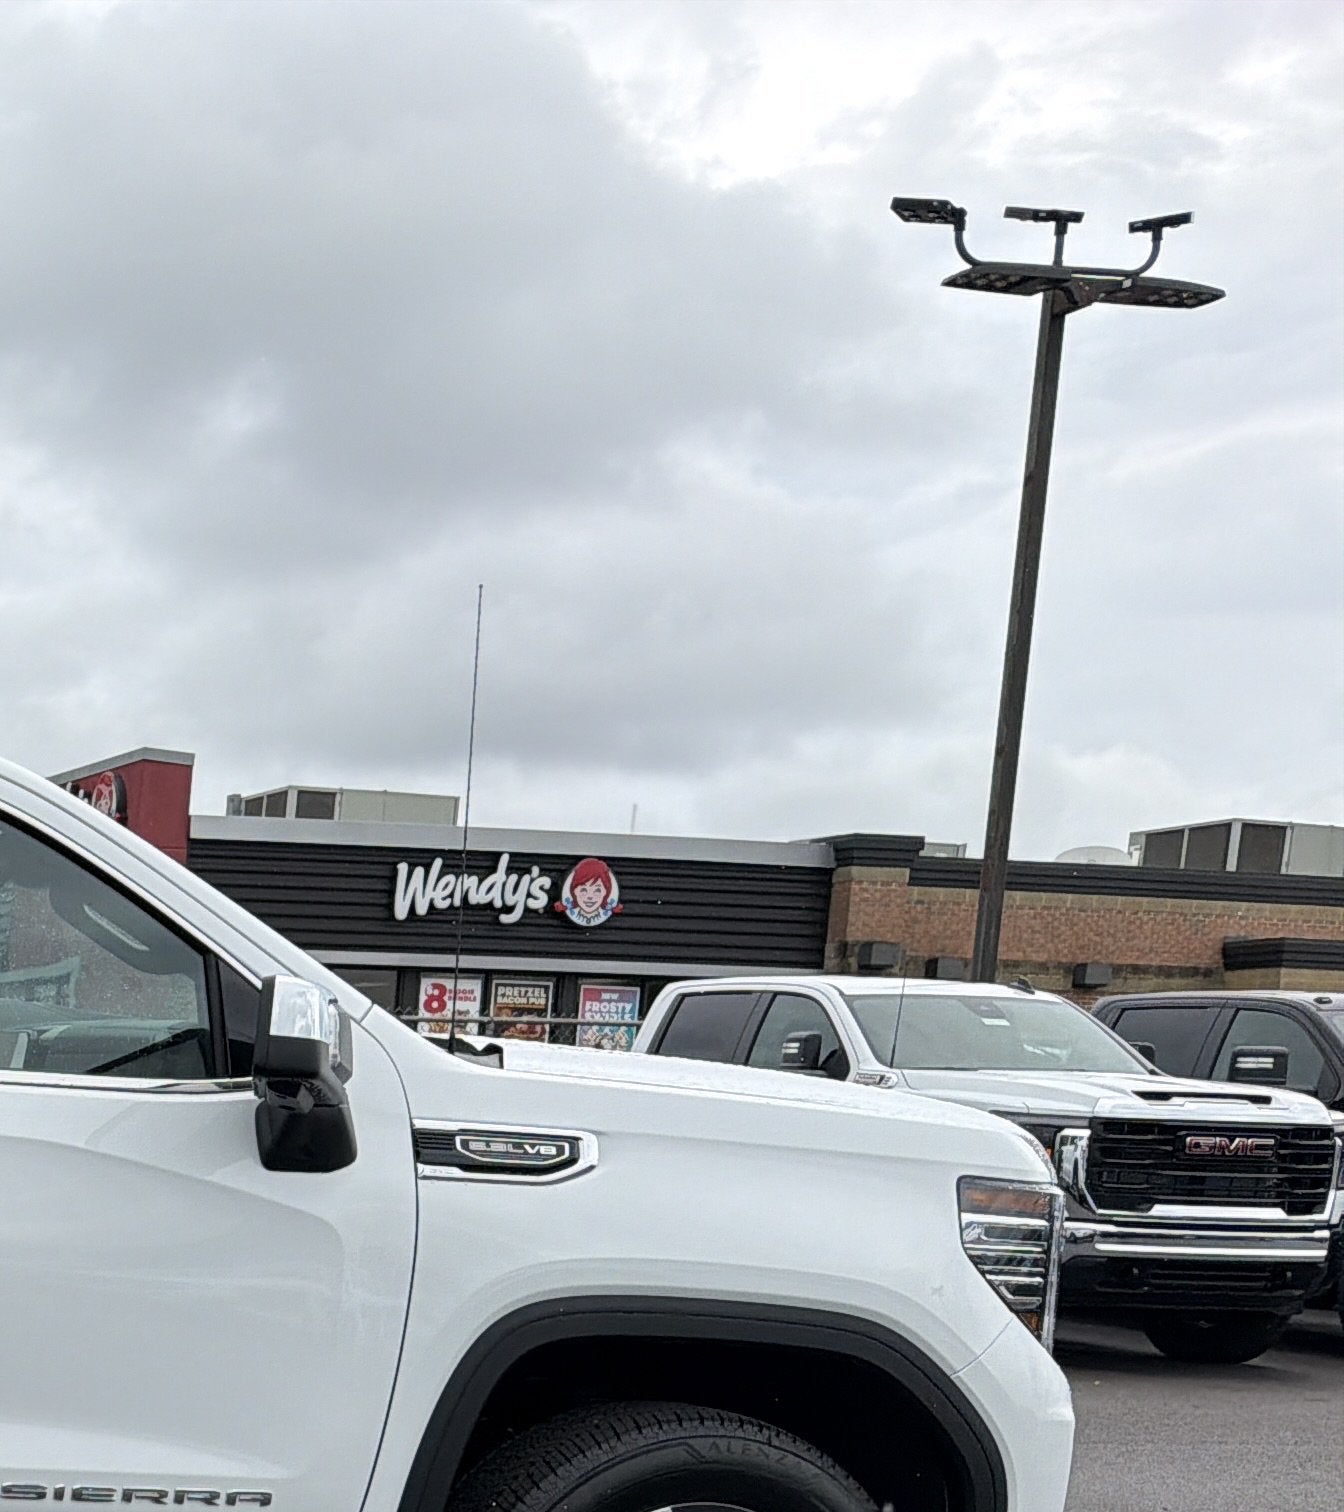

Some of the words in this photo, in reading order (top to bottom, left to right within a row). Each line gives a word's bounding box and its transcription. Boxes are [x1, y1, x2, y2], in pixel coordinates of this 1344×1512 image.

[394, 852, 552, 925] Wendy's
[497, 986, 547, 998] PRETZEL
[496, 996, 528, 1005] BACON
[585, 1001, 633, 1013] FROSTY
[1185, 1136, 1275, 1157] GMC
[0, 1481, 273, 1508] SIERRA
